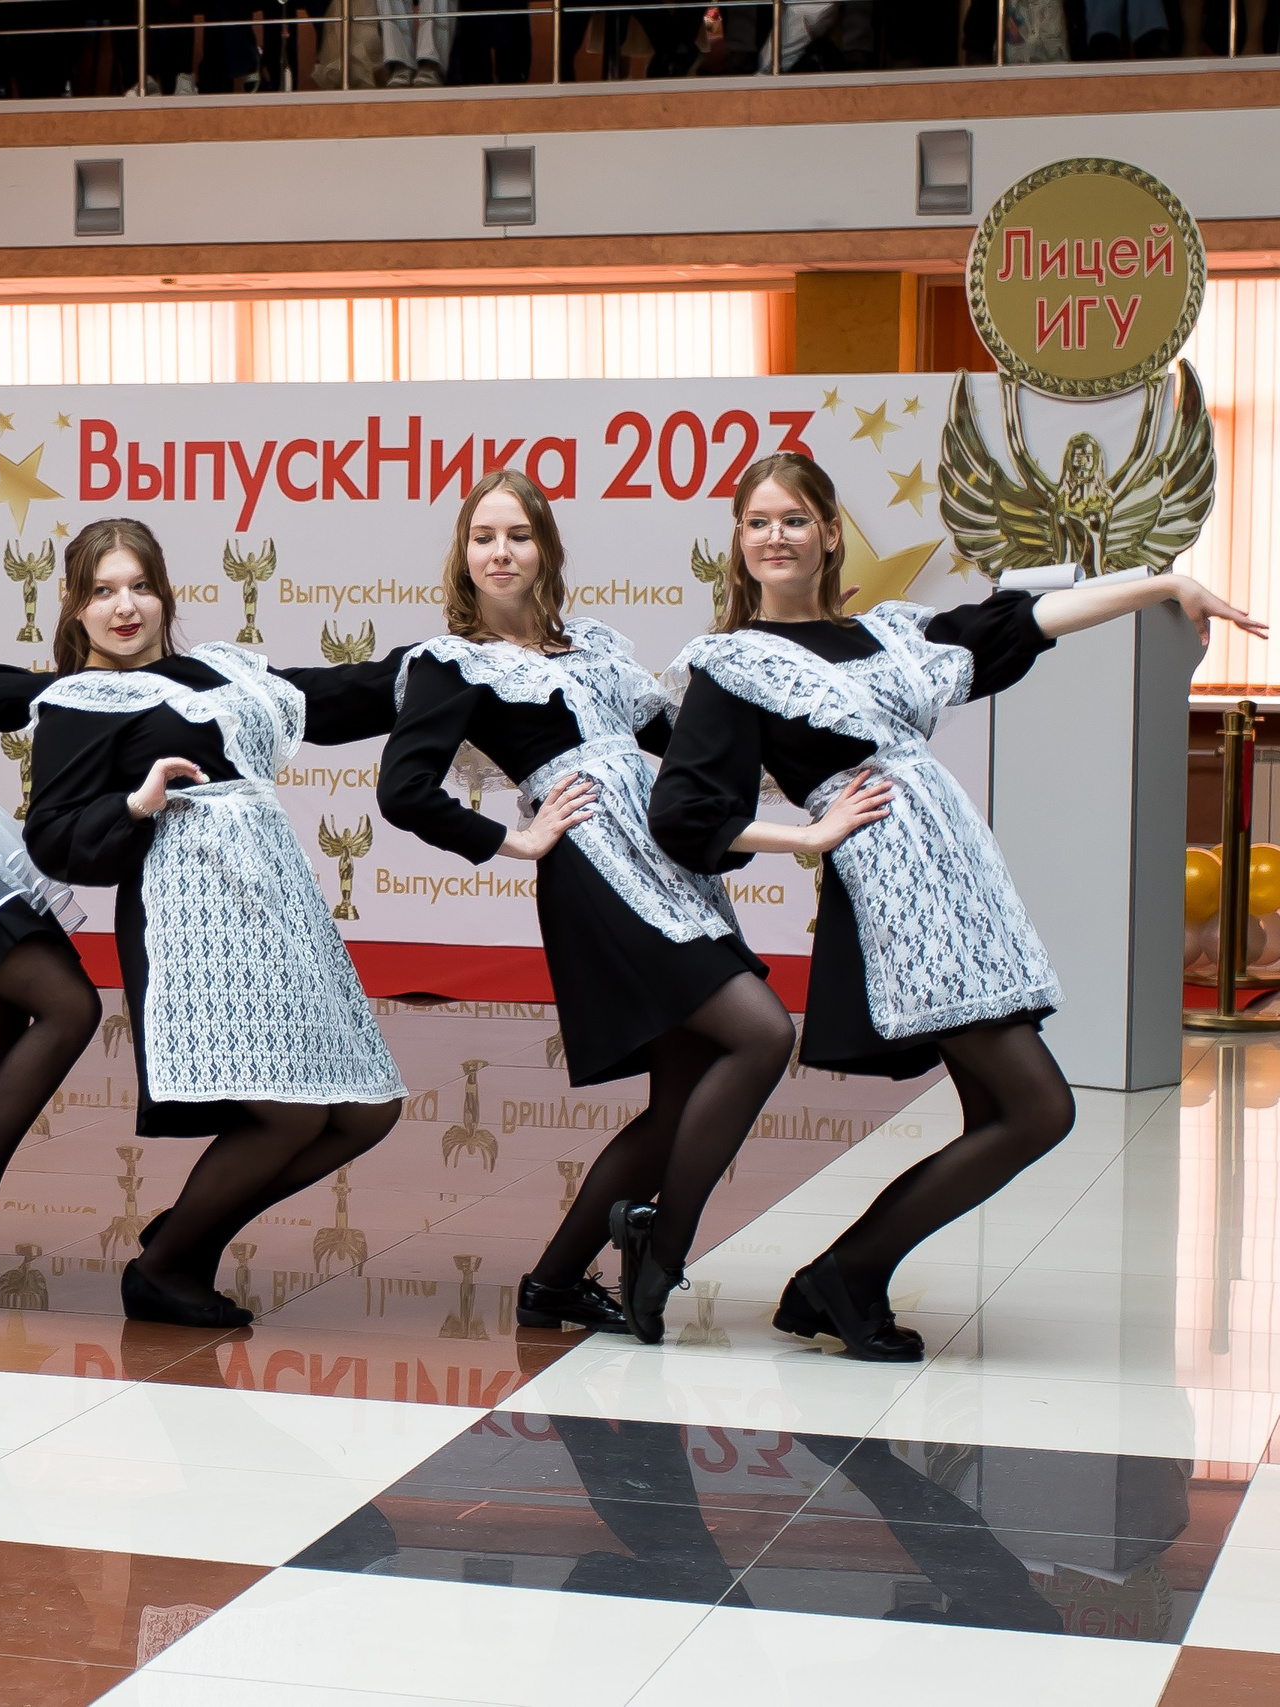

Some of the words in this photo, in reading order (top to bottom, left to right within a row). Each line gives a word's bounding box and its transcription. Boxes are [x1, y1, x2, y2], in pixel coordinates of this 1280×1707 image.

[997, 224, 1175, 286] Лицей
[1036, 294, 1142, 353] ИГУ
[79, 415, 578, 532] ВыпускНика
[600, 409, 816, 501] 2023
[564, 579, 684, 615] ускНика
